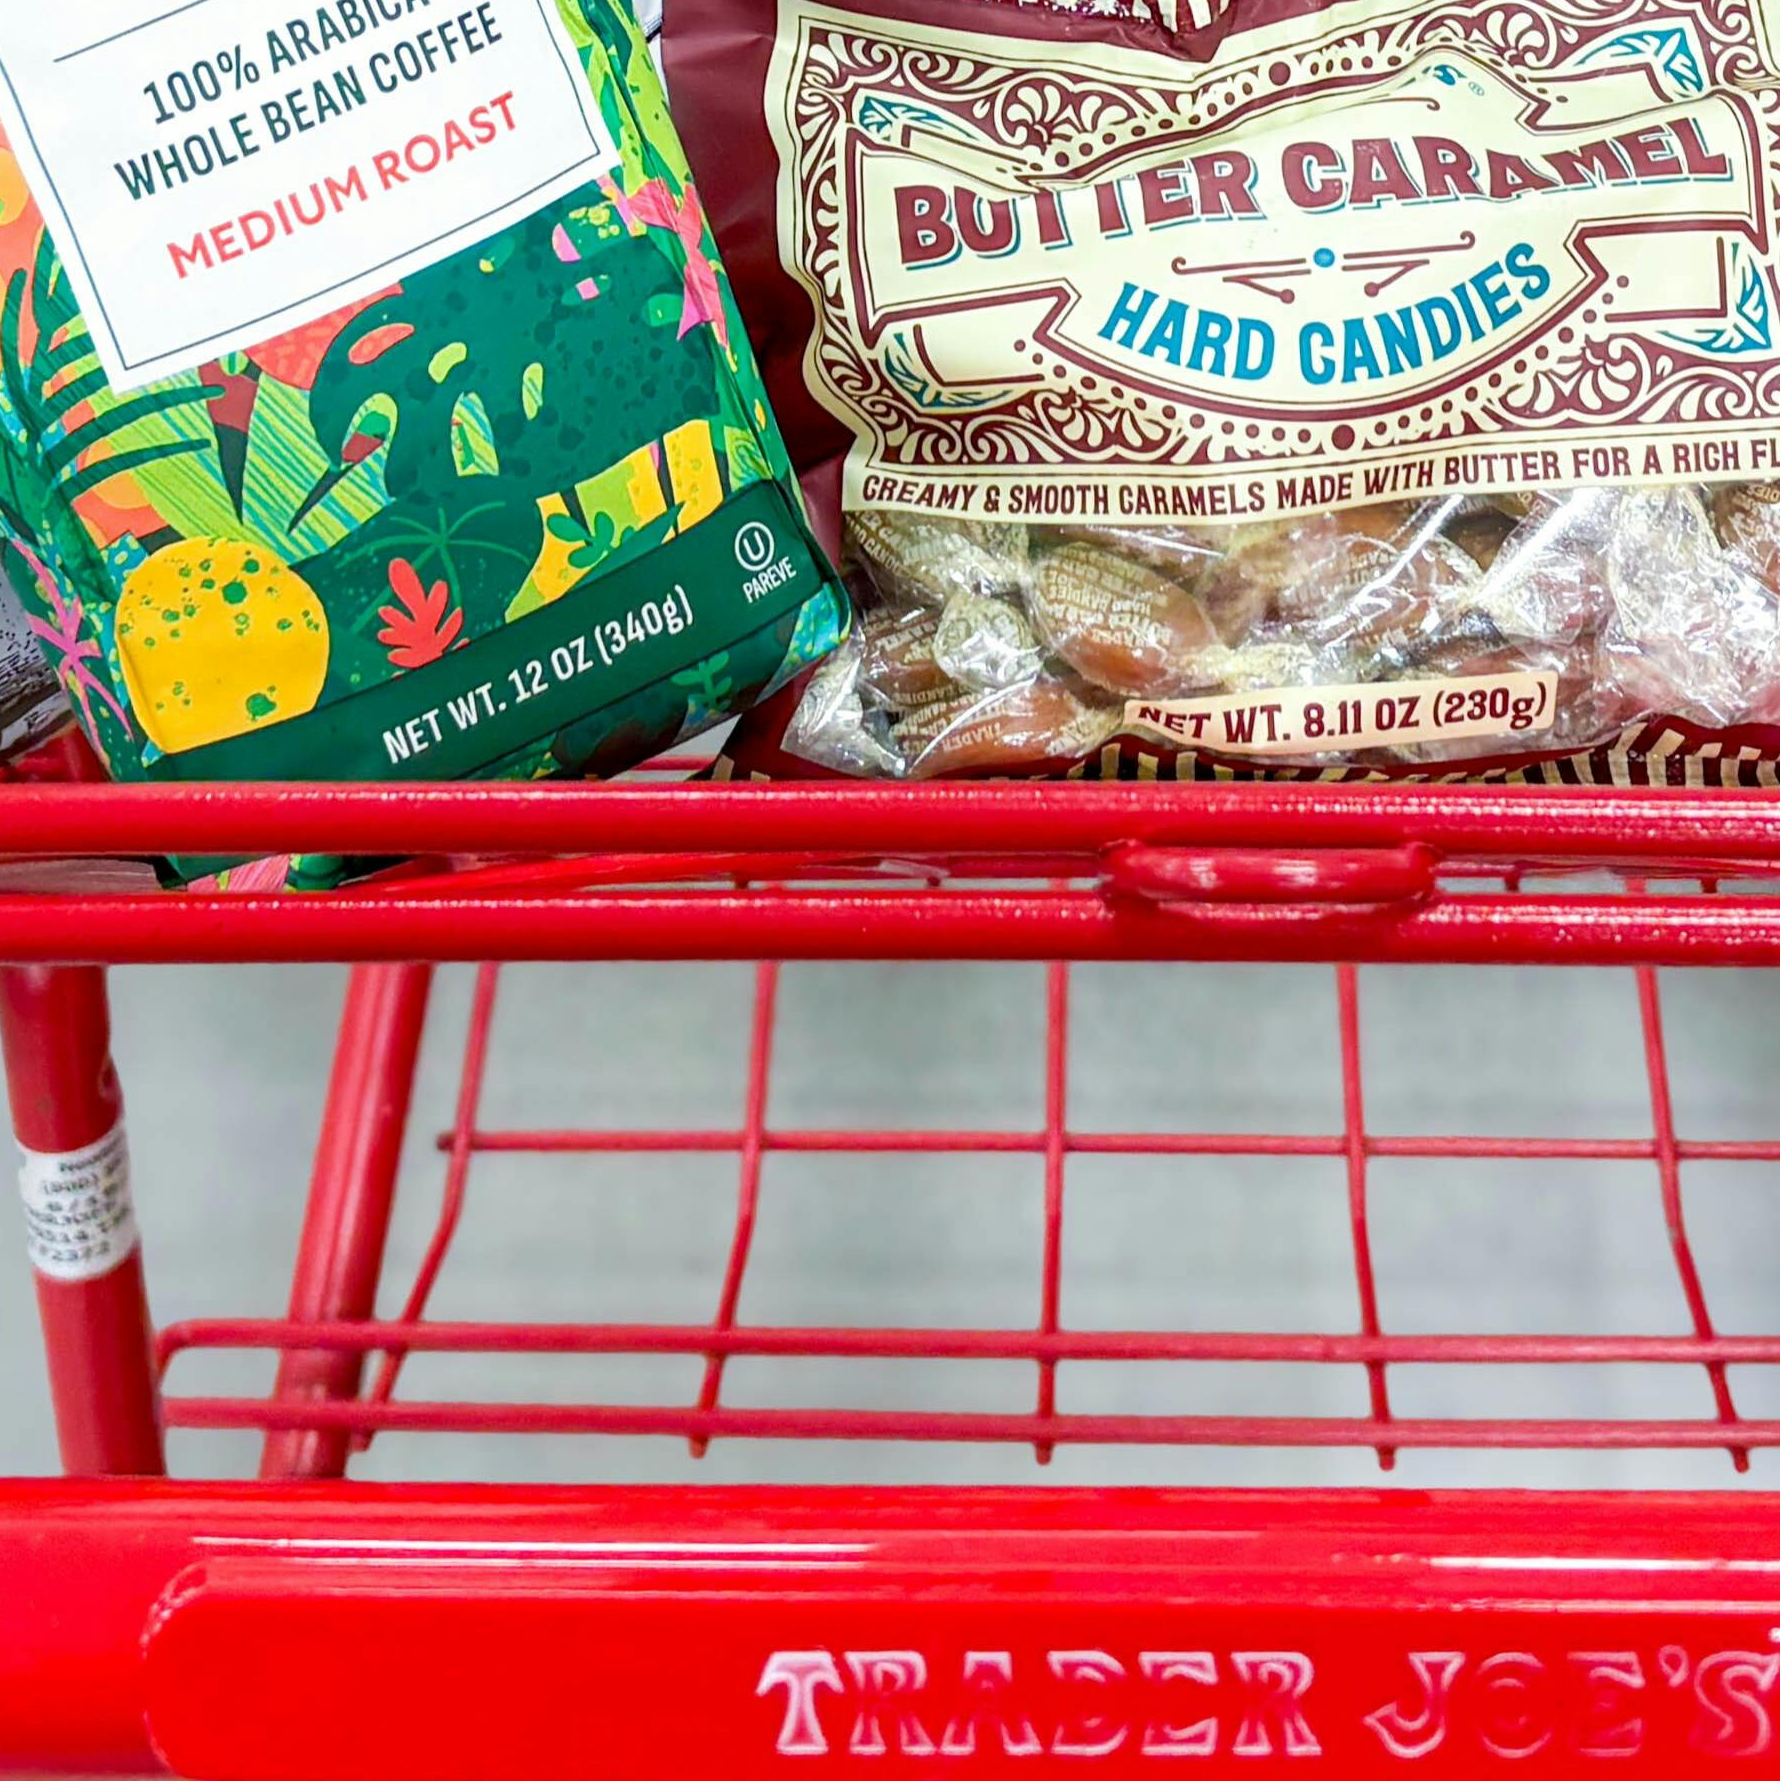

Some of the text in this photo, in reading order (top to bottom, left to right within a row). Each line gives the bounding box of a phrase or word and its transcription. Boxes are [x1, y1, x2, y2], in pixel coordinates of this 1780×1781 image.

[113, 0, 504, 203] WHOLE BEAN COFFEE
[141, 40, 261, 126] 100%
[165, 89, 523, 281] MEDIUM ROAST
[892, 113, 1739, 270] BUTTER CARAMEL
[1097, 241, 1554, 387] HARD CANDIES
[861, 473, 979, 513] CREAMY
[984, 483, 1000, 514] &
[1007, 483, 1109, 515] SMOOTH
[1118, 480, 1266, 517] CARAMELS
[1275, 470, 1355, 507] MADE
[1362, 458, 1434, 497] WITH
[1442, 448, 1561, 486] BUTTER
[1572, 445, 1632, 478] FOR
[1641, 443, 1663, 474] A
[1670, 439, 1742, 473] RICH
[741, 555, 797, 604] PAREVE
[381, 583, 694, 764] NET WT. 12 OZ (340g)
[1137, 681, 1548, 744] NET WT. 8.11 OZ (230g)
[755, 1647, 1322, 1758] TRADER
